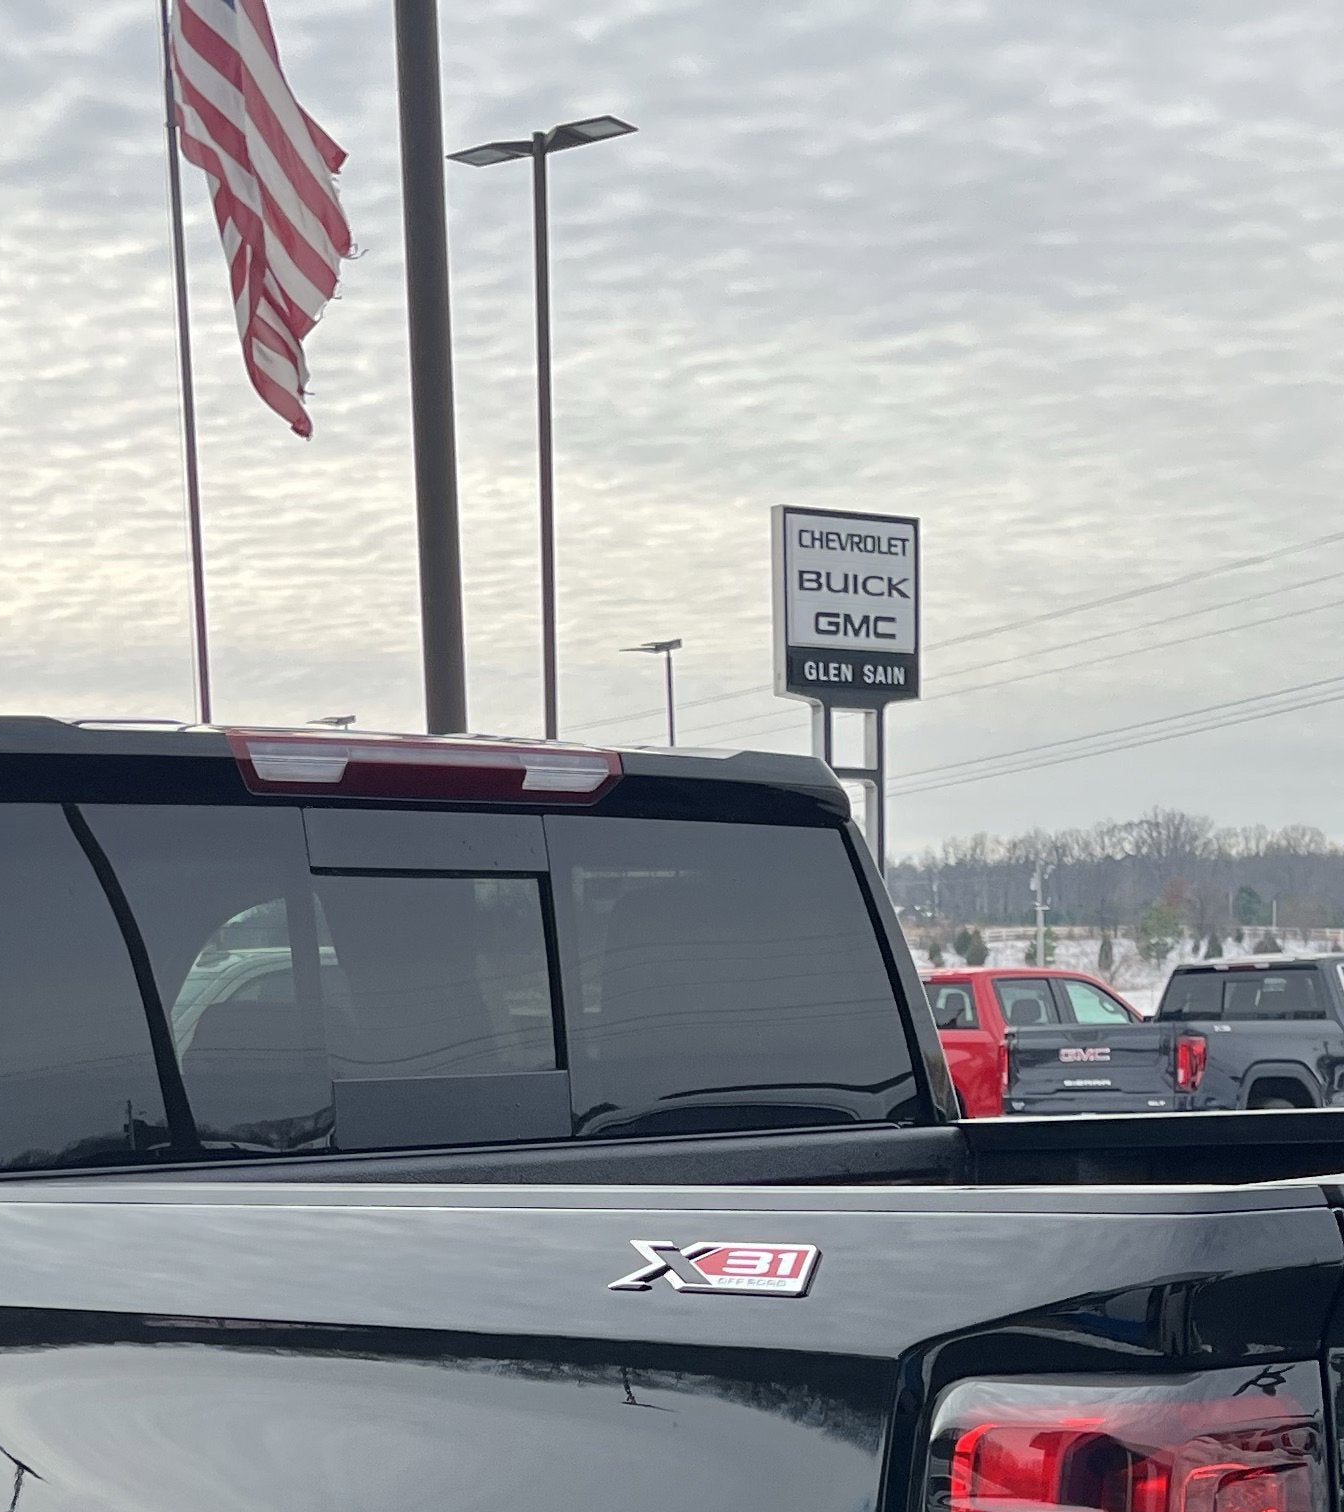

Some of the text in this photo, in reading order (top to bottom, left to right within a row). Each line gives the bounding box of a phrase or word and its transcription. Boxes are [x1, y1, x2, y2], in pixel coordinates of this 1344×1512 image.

[798, 528, 910, 557] CHEVROLET
[797, 570, 912, 600] BUICK
[814, 611, 898, 640] GMC
[803, 660, 906, 686] GLEN SAIN
[1058, 1047, 1112, 1063] GMC
[607, 1240, 806, 1293] X31
